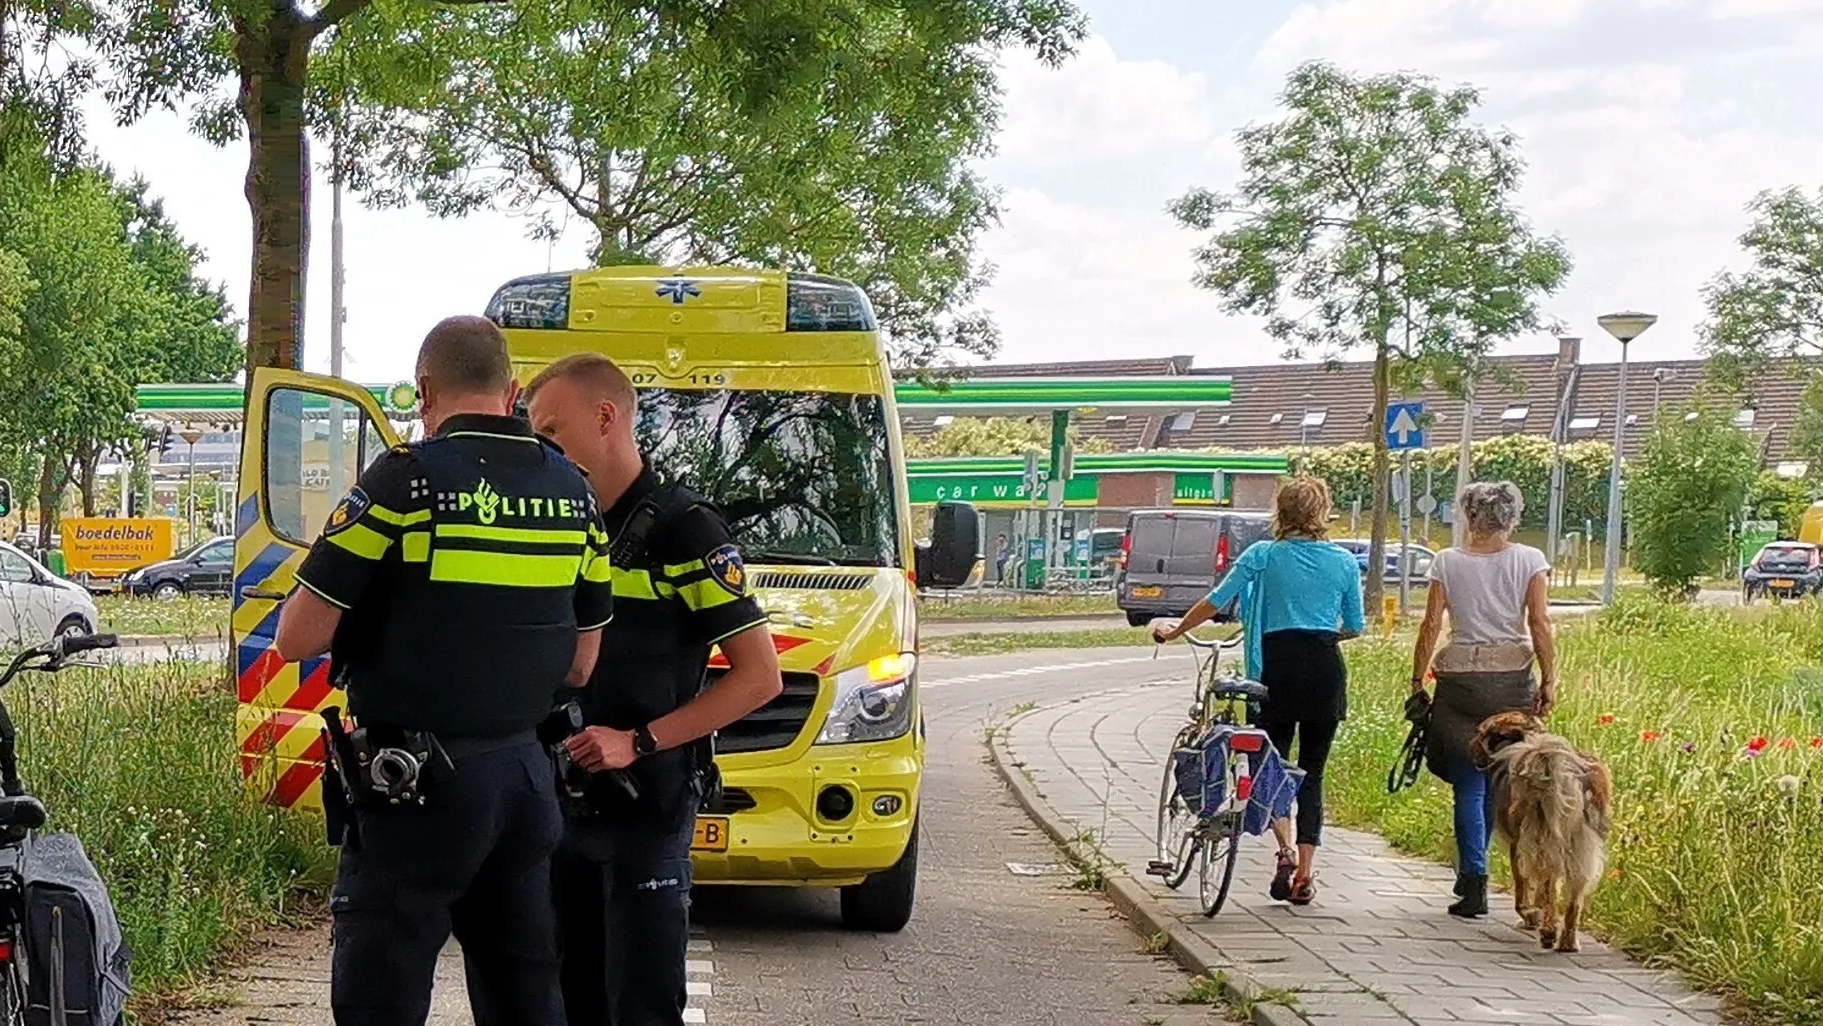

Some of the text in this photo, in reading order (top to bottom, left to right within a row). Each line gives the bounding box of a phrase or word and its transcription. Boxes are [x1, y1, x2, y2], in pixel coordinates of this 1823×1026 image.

[632, 373, 725, 385] 07 119
[936, 485, 978, 499] car
[76, 525, 154, 541] boedelbak
